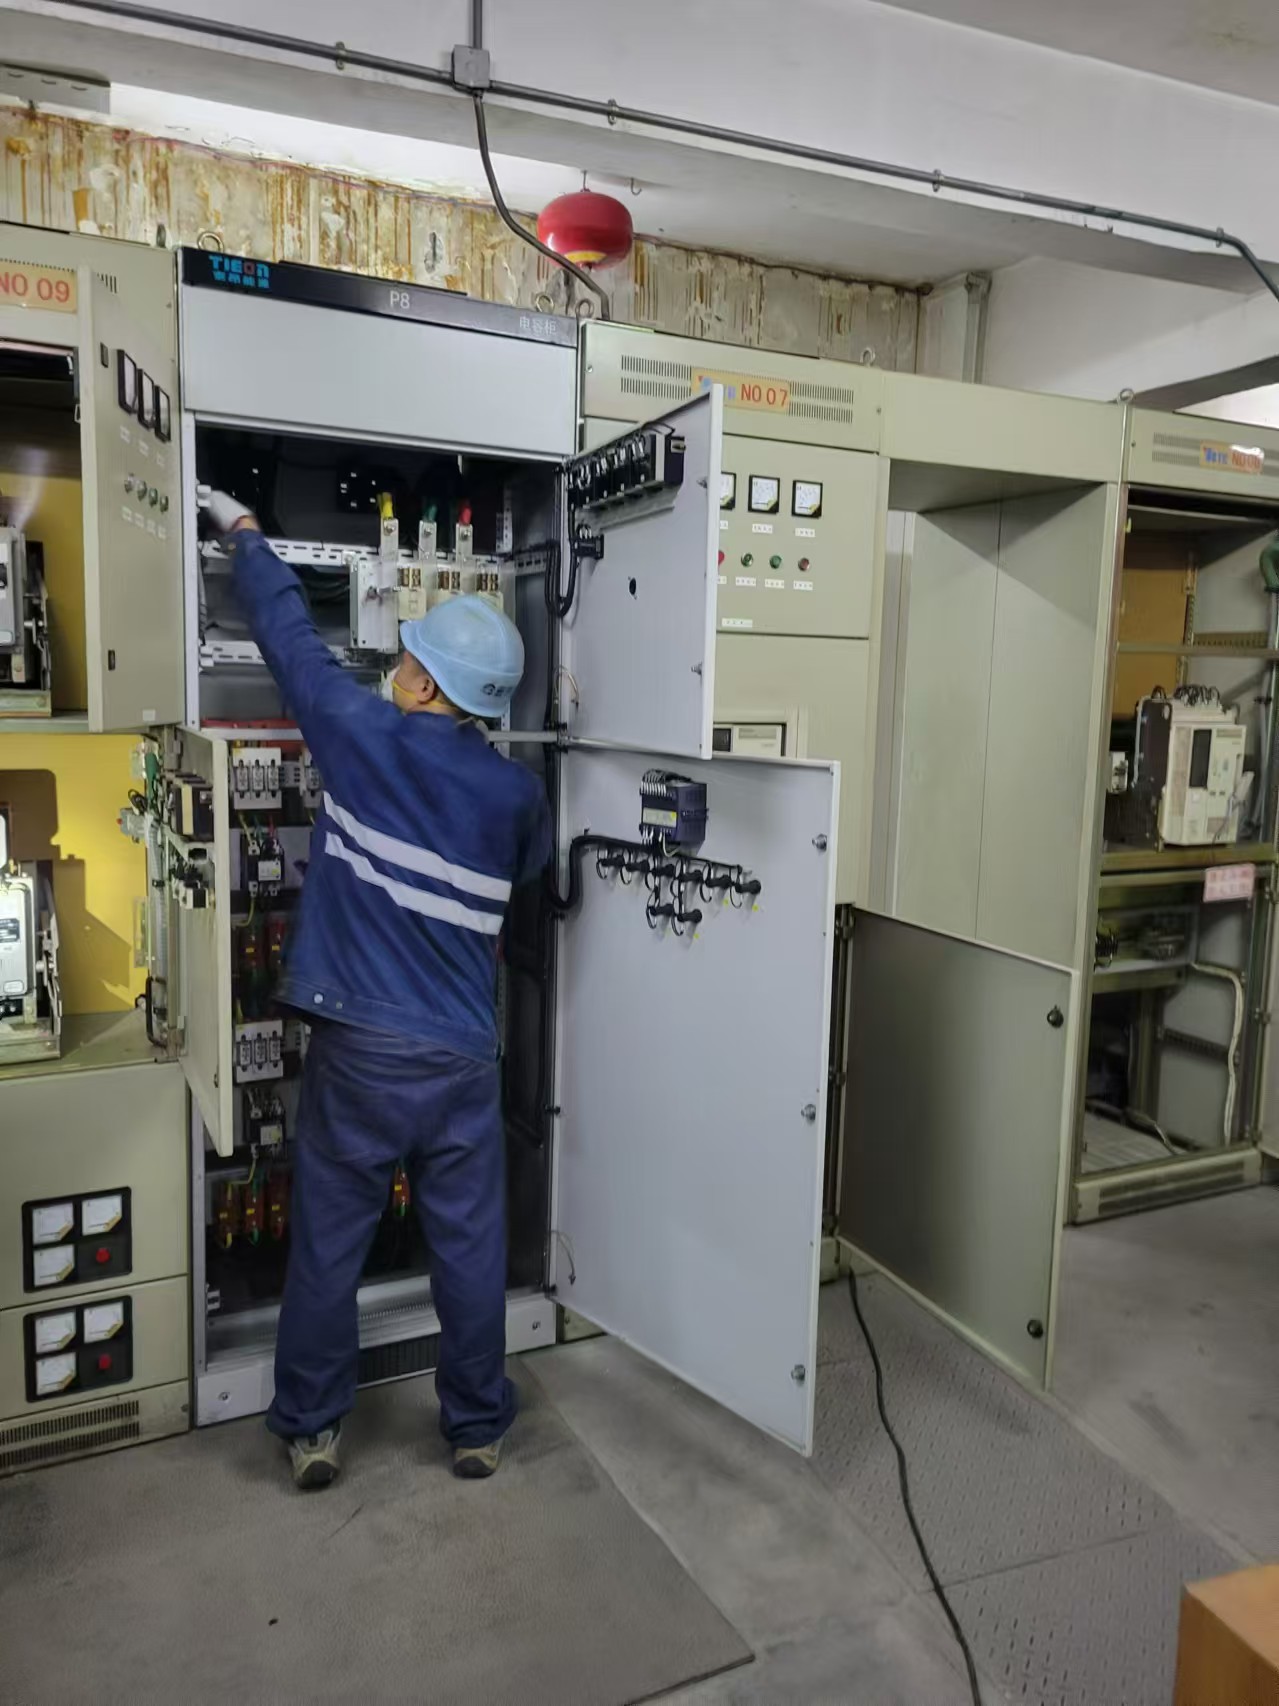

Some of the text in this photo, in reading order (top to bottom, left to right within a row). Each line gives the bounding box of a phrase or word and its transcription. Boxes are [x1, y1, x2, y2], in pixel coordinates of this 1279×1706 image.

[37, 277, 70, 303] 09
[389, 290, 411, 310] P8
[519, 315, 556, 335] 电容柜
[741, 383, 762, 403] NO
[766, 387, 788, 407] 07
